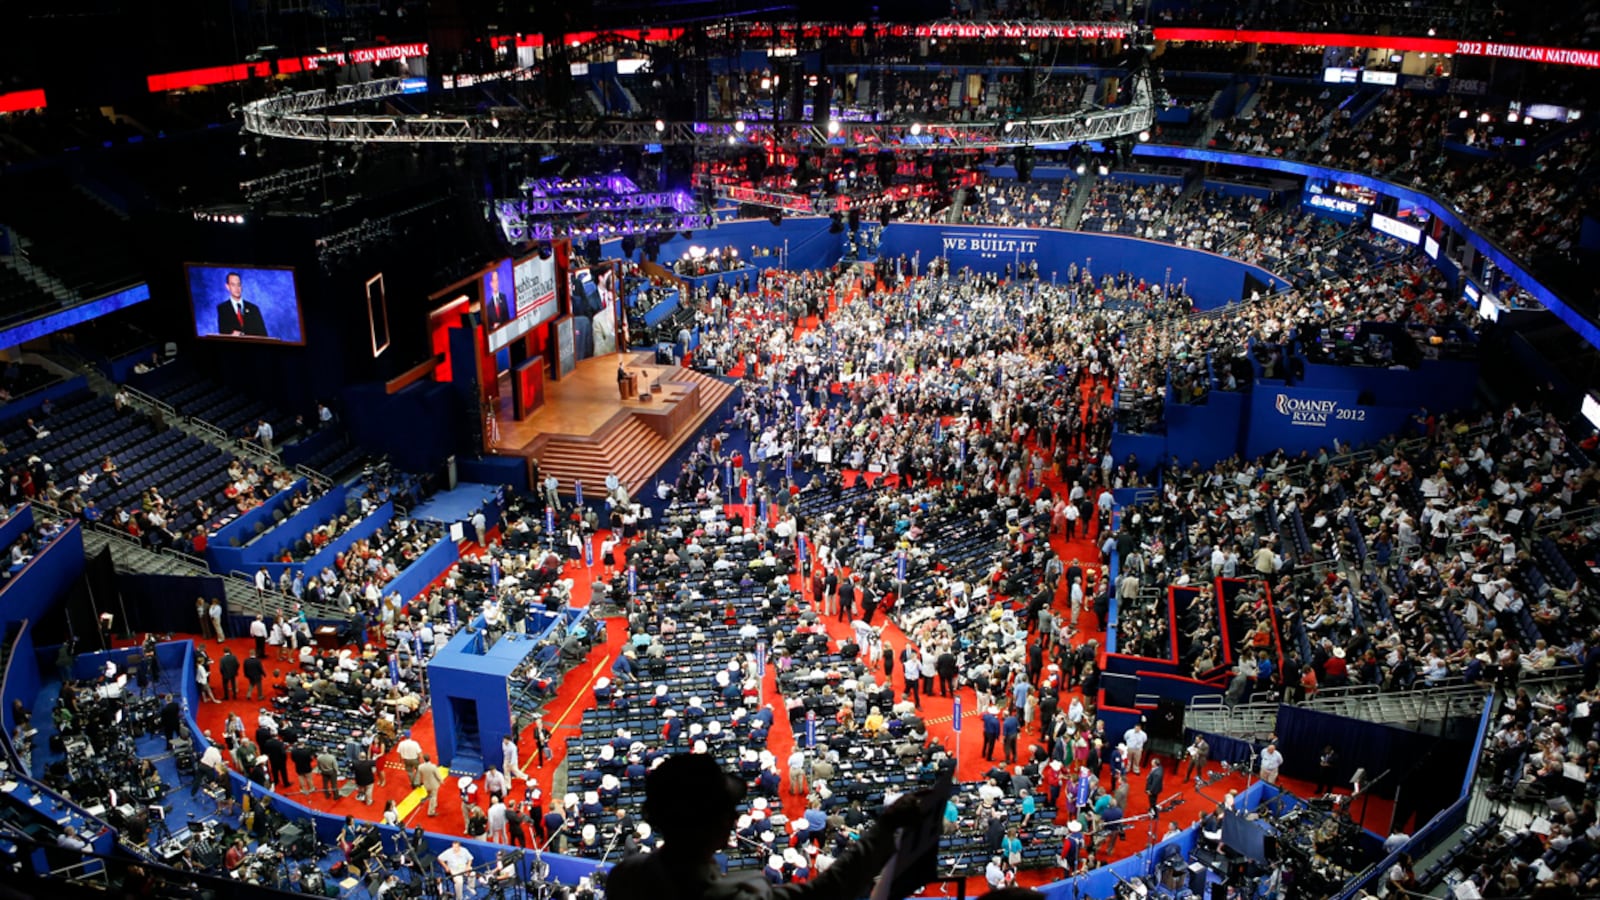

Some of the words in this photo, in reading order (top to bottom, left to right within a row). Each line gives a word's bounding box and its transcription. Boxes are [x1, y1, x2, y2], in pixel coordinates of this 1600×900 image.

[376, 43, 420, 61] NATIONAL
[1456, 42, 1482, 54] 2012
[1485, 43, 1543, 60] REPUBLICAN
[1546, 49, 1600, 67] NATIONAL
[942, 238, 967, 250] WE
[970, 239, 1016, 252] BUILT
[1020, 241, 1037, 253] IT
[1275, 393, 1337, 415] ROMNEY
[1292, 412, 1327, 422] RYAN
[1335, 409, 1365, 420] 2012
